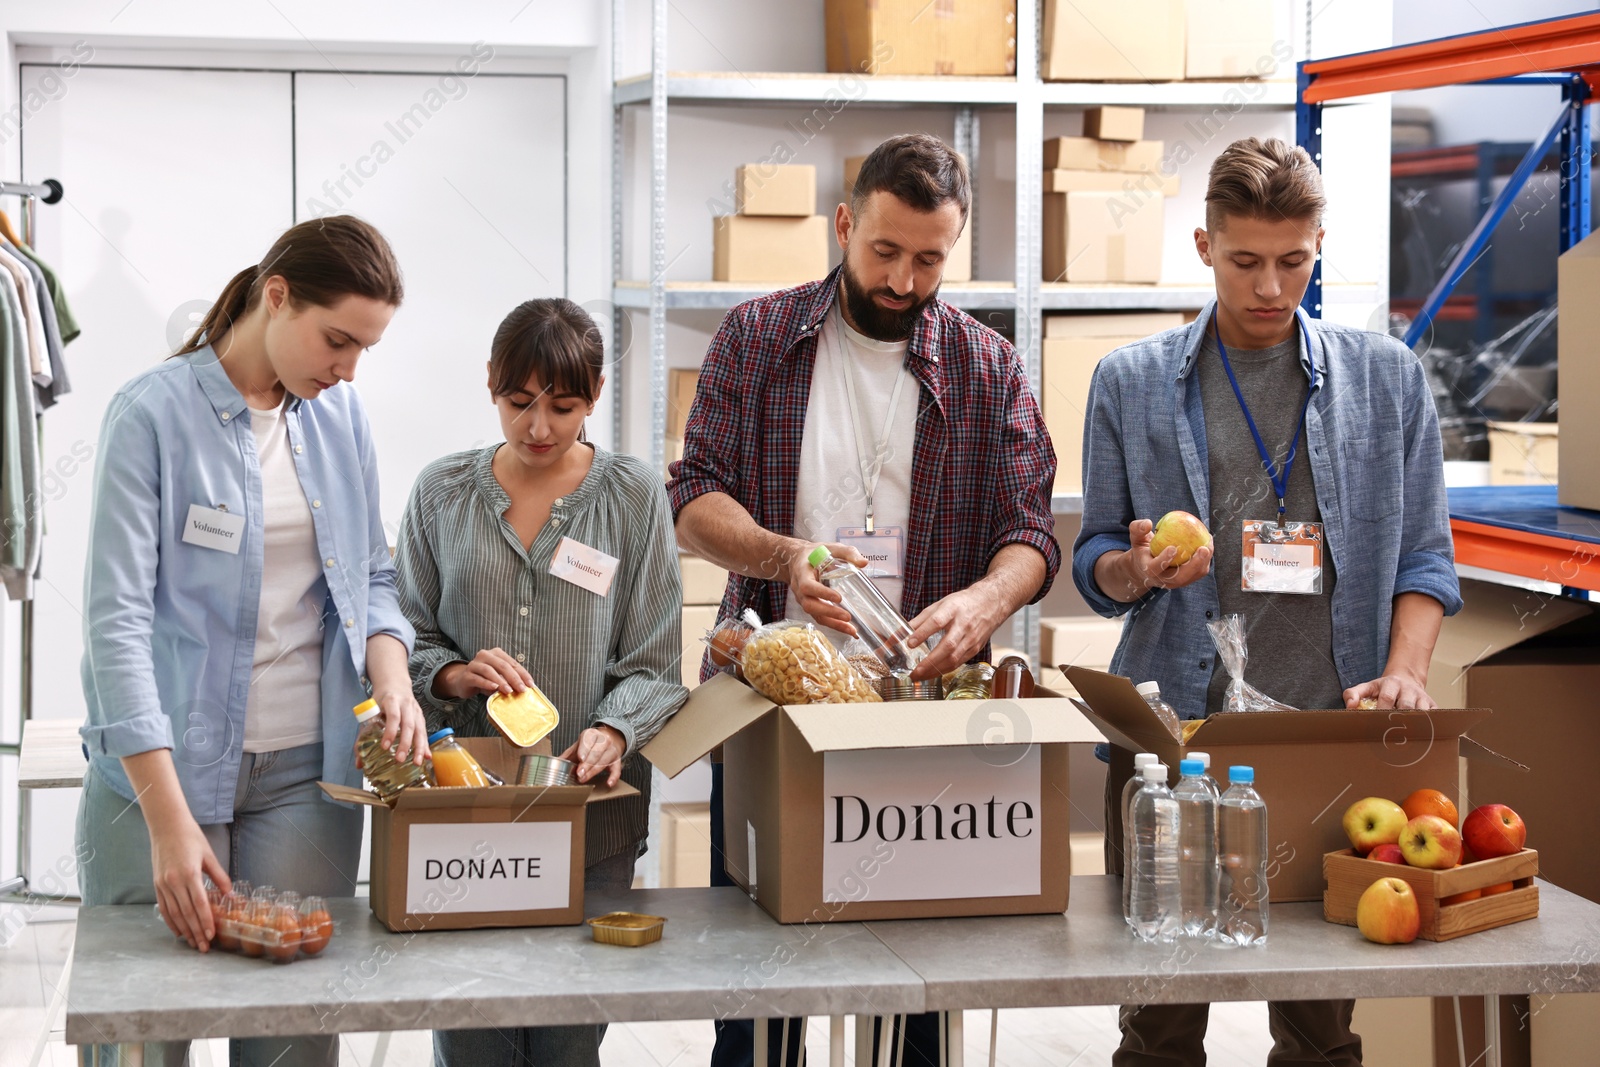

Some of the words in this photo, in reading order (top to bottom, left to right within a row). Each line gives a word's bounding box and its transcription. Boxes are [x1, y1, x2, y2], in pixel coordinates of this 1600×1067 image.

[193, 520, 235, 538] Volunteer
[567, 555, 603, 577] Volunteer
[1260, 558, 1300, 567] Volunteer
[830, 795, 1034, 843] Donate
[425, 857, 541, 880] DONATE
